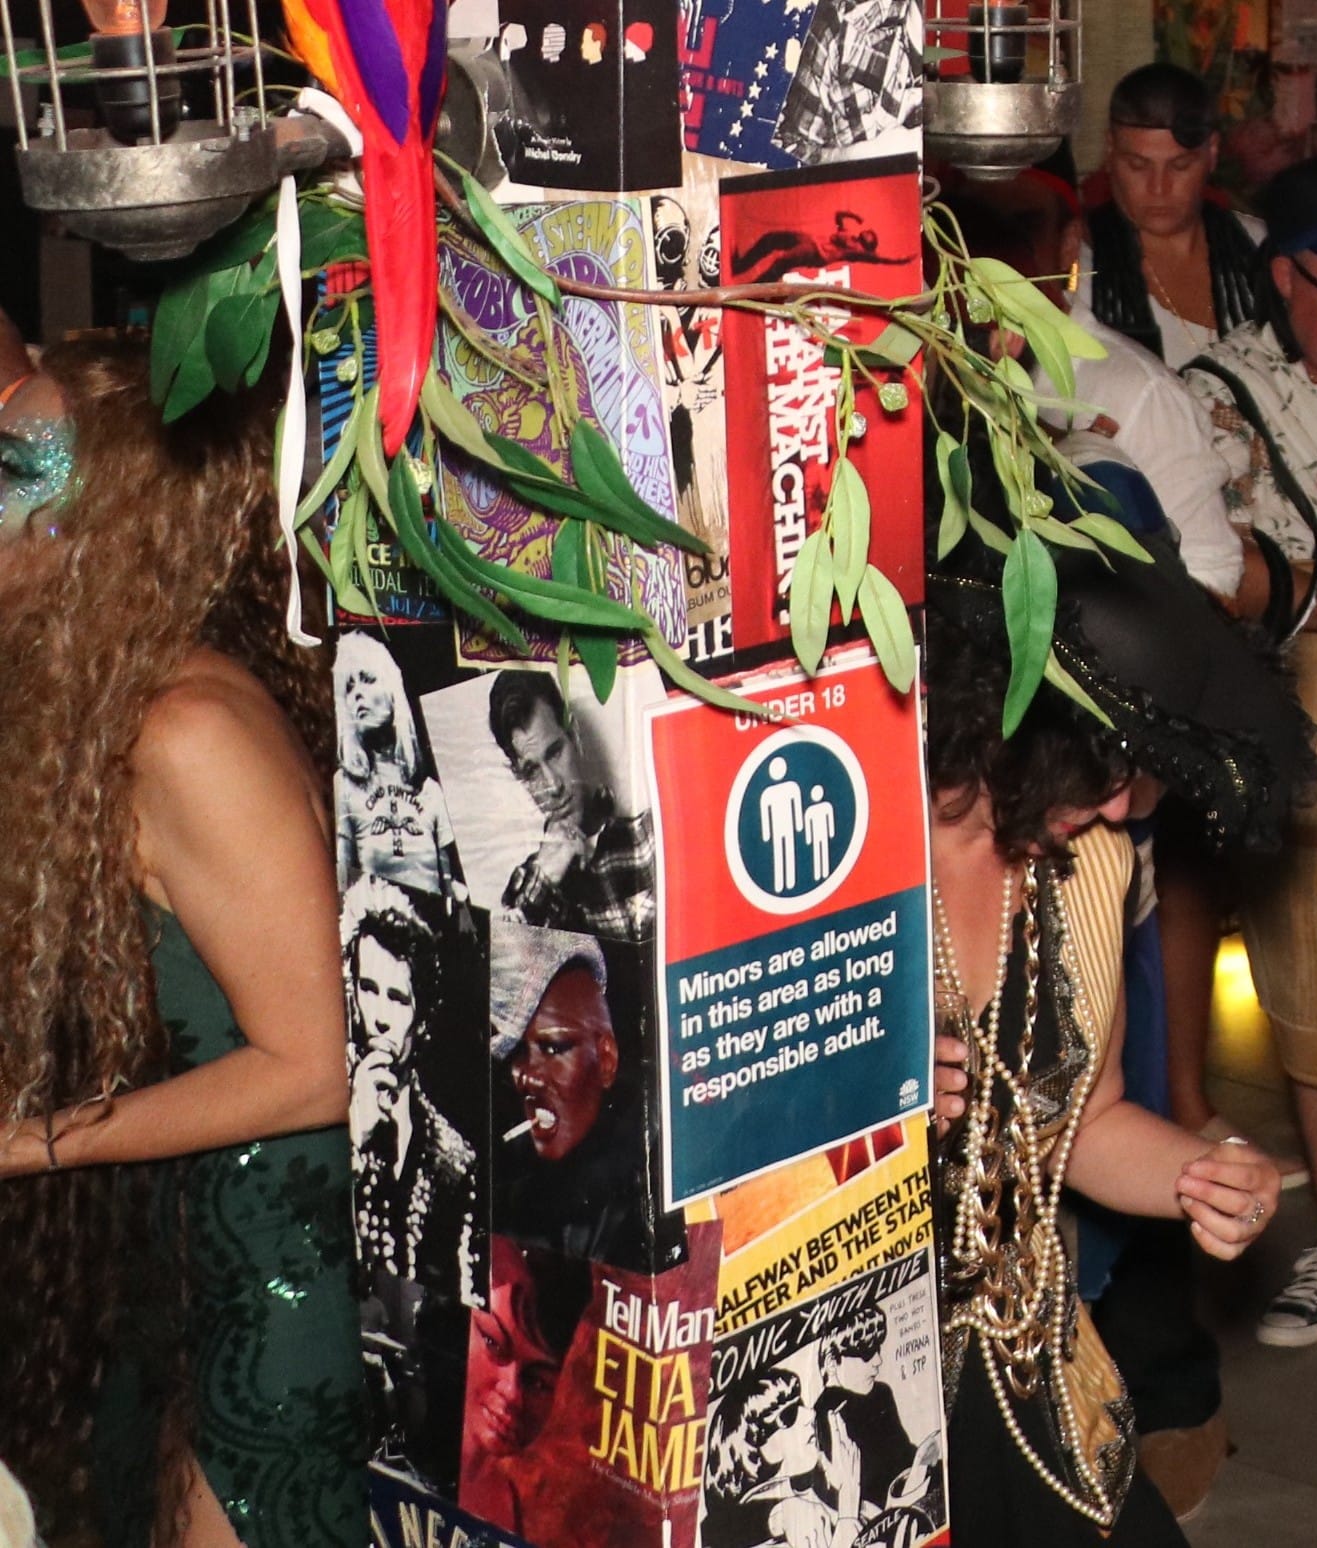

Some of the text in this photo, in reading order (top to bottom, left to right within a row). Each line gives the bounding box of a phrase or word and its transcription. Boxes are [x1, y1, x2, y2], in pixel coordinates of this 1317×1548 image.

[767, 383, 808, 626] MACHI
[821, 683, 847, 710] 18
[679, 910, 898, 1005] Minors are allowed
[681, 949, 895, 1039] in this area as long
[681, 986, 882, 1074] as they are with a
[682, 1015, 886, 1107] responsible adult.
[715, 1245, 803, 1321] ALFWAY
[805, 1183, 902, 1262] BETWEEN
[796, 1254, 839, 1296] AND
[841, 1221, 882, 1262] THE
[883, 1231, 913, 1264] NOV
[602, 1278, 643, 1343] Tell
[797, 1276, 876, 1345] YOUTH
[875, 1249, 927, 1305] LIVE
[594, 1328, 696, 1424] ETTA
